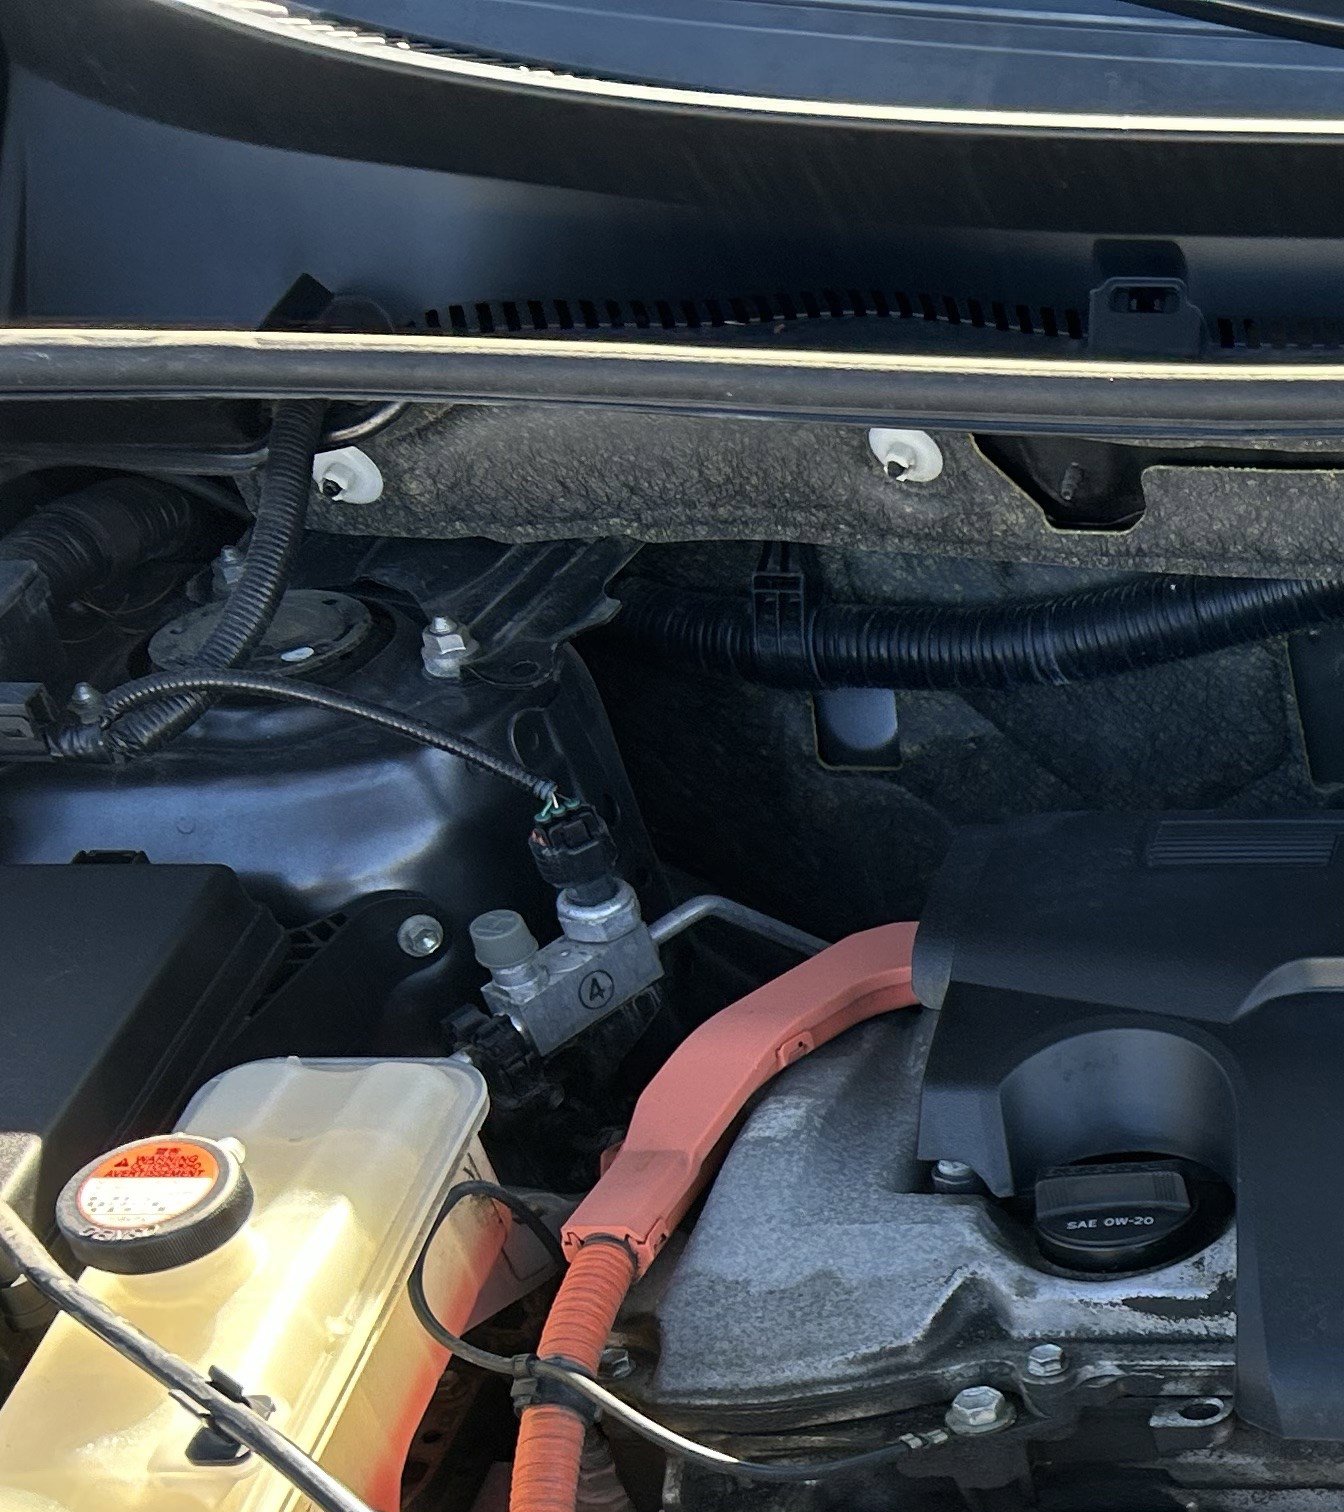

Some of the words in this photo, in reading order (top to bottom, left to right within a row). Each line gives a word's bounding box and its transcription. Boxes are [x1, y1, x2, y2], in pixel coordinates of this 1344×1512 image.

[136, 1155, 198, 1164] WARNING
[1067, 1218, 1097, 1230] SAE
[1103, 1216, 1155, 1228] 0W-20
